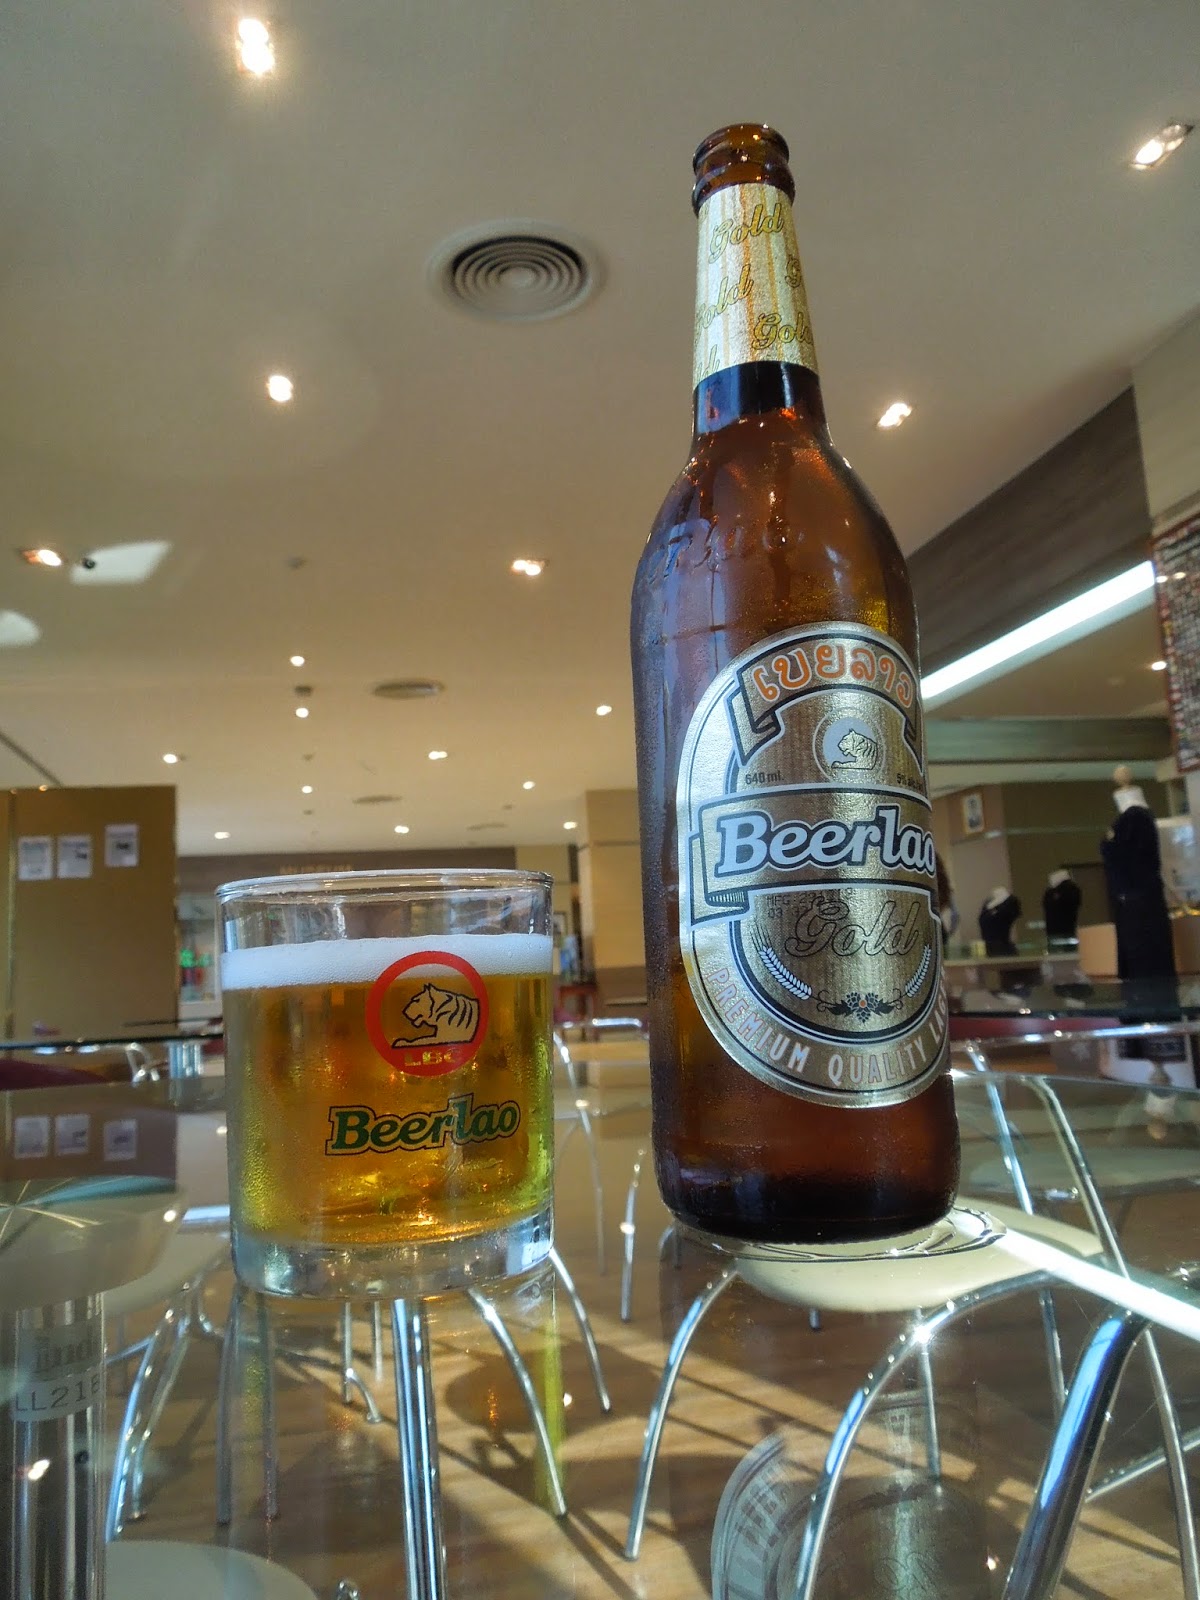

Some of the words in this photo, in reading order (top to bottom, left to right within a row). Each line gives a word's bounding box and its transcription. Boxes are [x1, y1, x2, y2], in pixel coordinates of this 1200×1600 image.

[708, 202, 784, 264] Gold
[745, 772, 765, 785] 640
[715, 806, 936, 877] Beerlao
[784, 896, 921, 958] Gold
[708, 967, 811, 1074] PREMIUM
[828, 1038, 928, 1087] QUALITY
[327, 1094, 520, 1154] Beerlao
